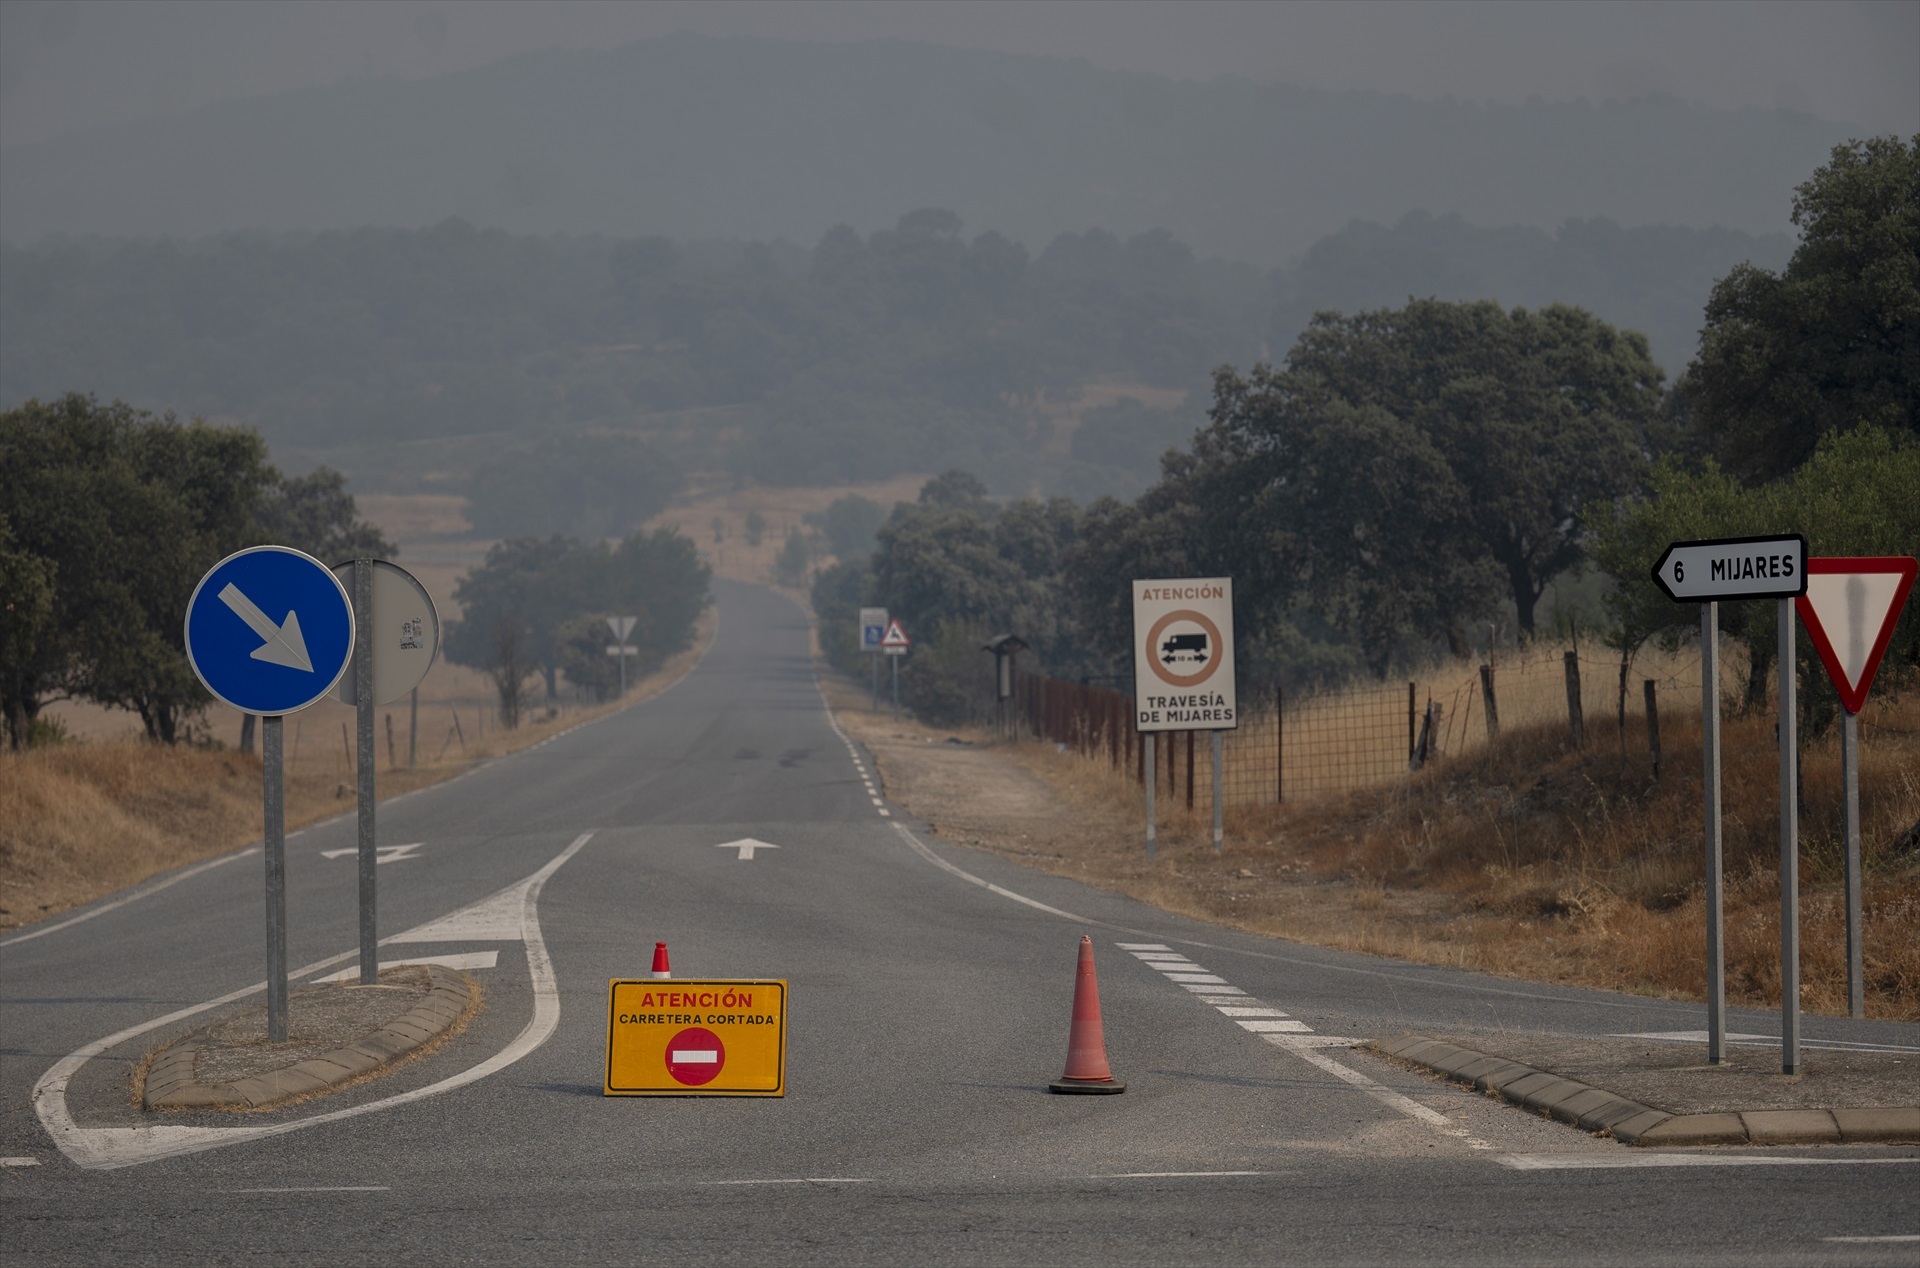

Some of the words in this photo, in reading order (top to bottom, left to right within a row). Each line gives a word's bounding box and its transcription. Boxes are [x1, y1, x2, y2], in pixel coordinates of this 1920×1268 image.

[1673, 560, 1685, 583] 6
[1710, 554, 1794, 582] MIJARES
[1142, 583, 1224, 601] ATENCIÓN
[1147, 691, 1225, 709] TRAVESÍA
[1140, 711, 1160, 723] DE
[1167, 708, 1233, 722] MIJARES
[641, 987, 753, 1008] ATENCIÓN
[619, 1013, 702, 1025] CARRETERA
[706, 1014, 775, 1025] CORTADA
